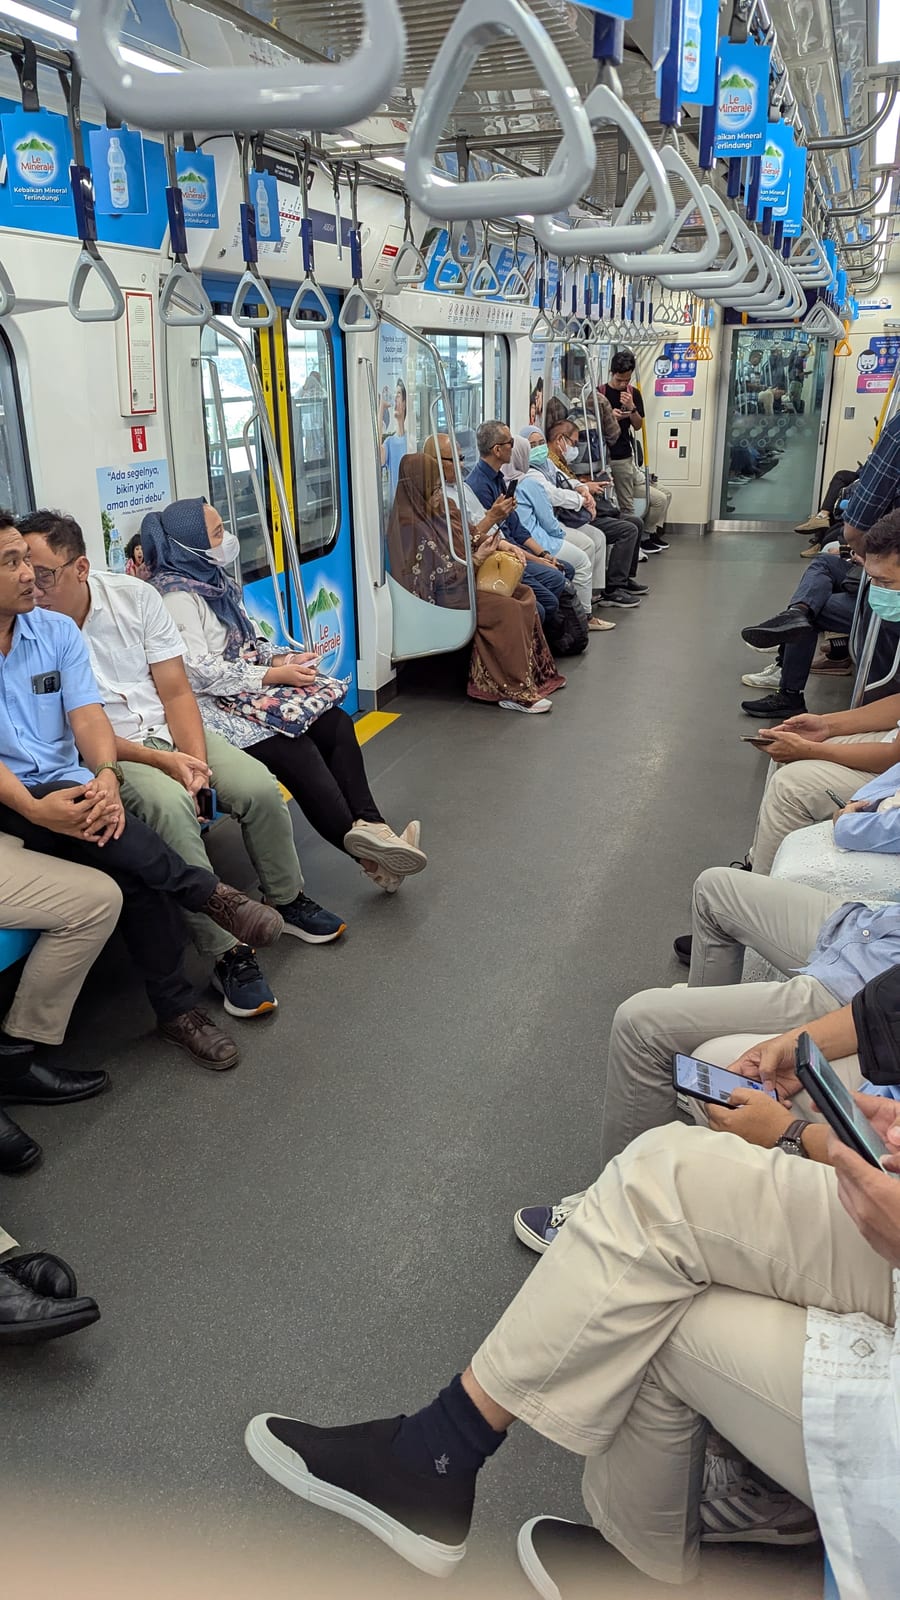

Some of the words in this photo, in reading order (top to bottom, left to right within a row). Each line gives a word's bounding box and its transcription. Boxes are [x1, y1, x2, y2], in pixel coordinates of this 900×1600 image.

[729, 94, 739, 104] Le
[736, 132, 762, 140] Mineral
[716, 141, 752, 150] erlindungi
[31, 155, 41, 164] Le
[21, 161, 54, 171] Minerale
[127, 467, 160, 480] segelnya,
[116, 483, 134, 495] bikin
[135, 480, 154, 494] yakin
[106, 500, 129, 511] aman
[130, 495, 144, 507] dari
[319, 624, 329, 640] Le
